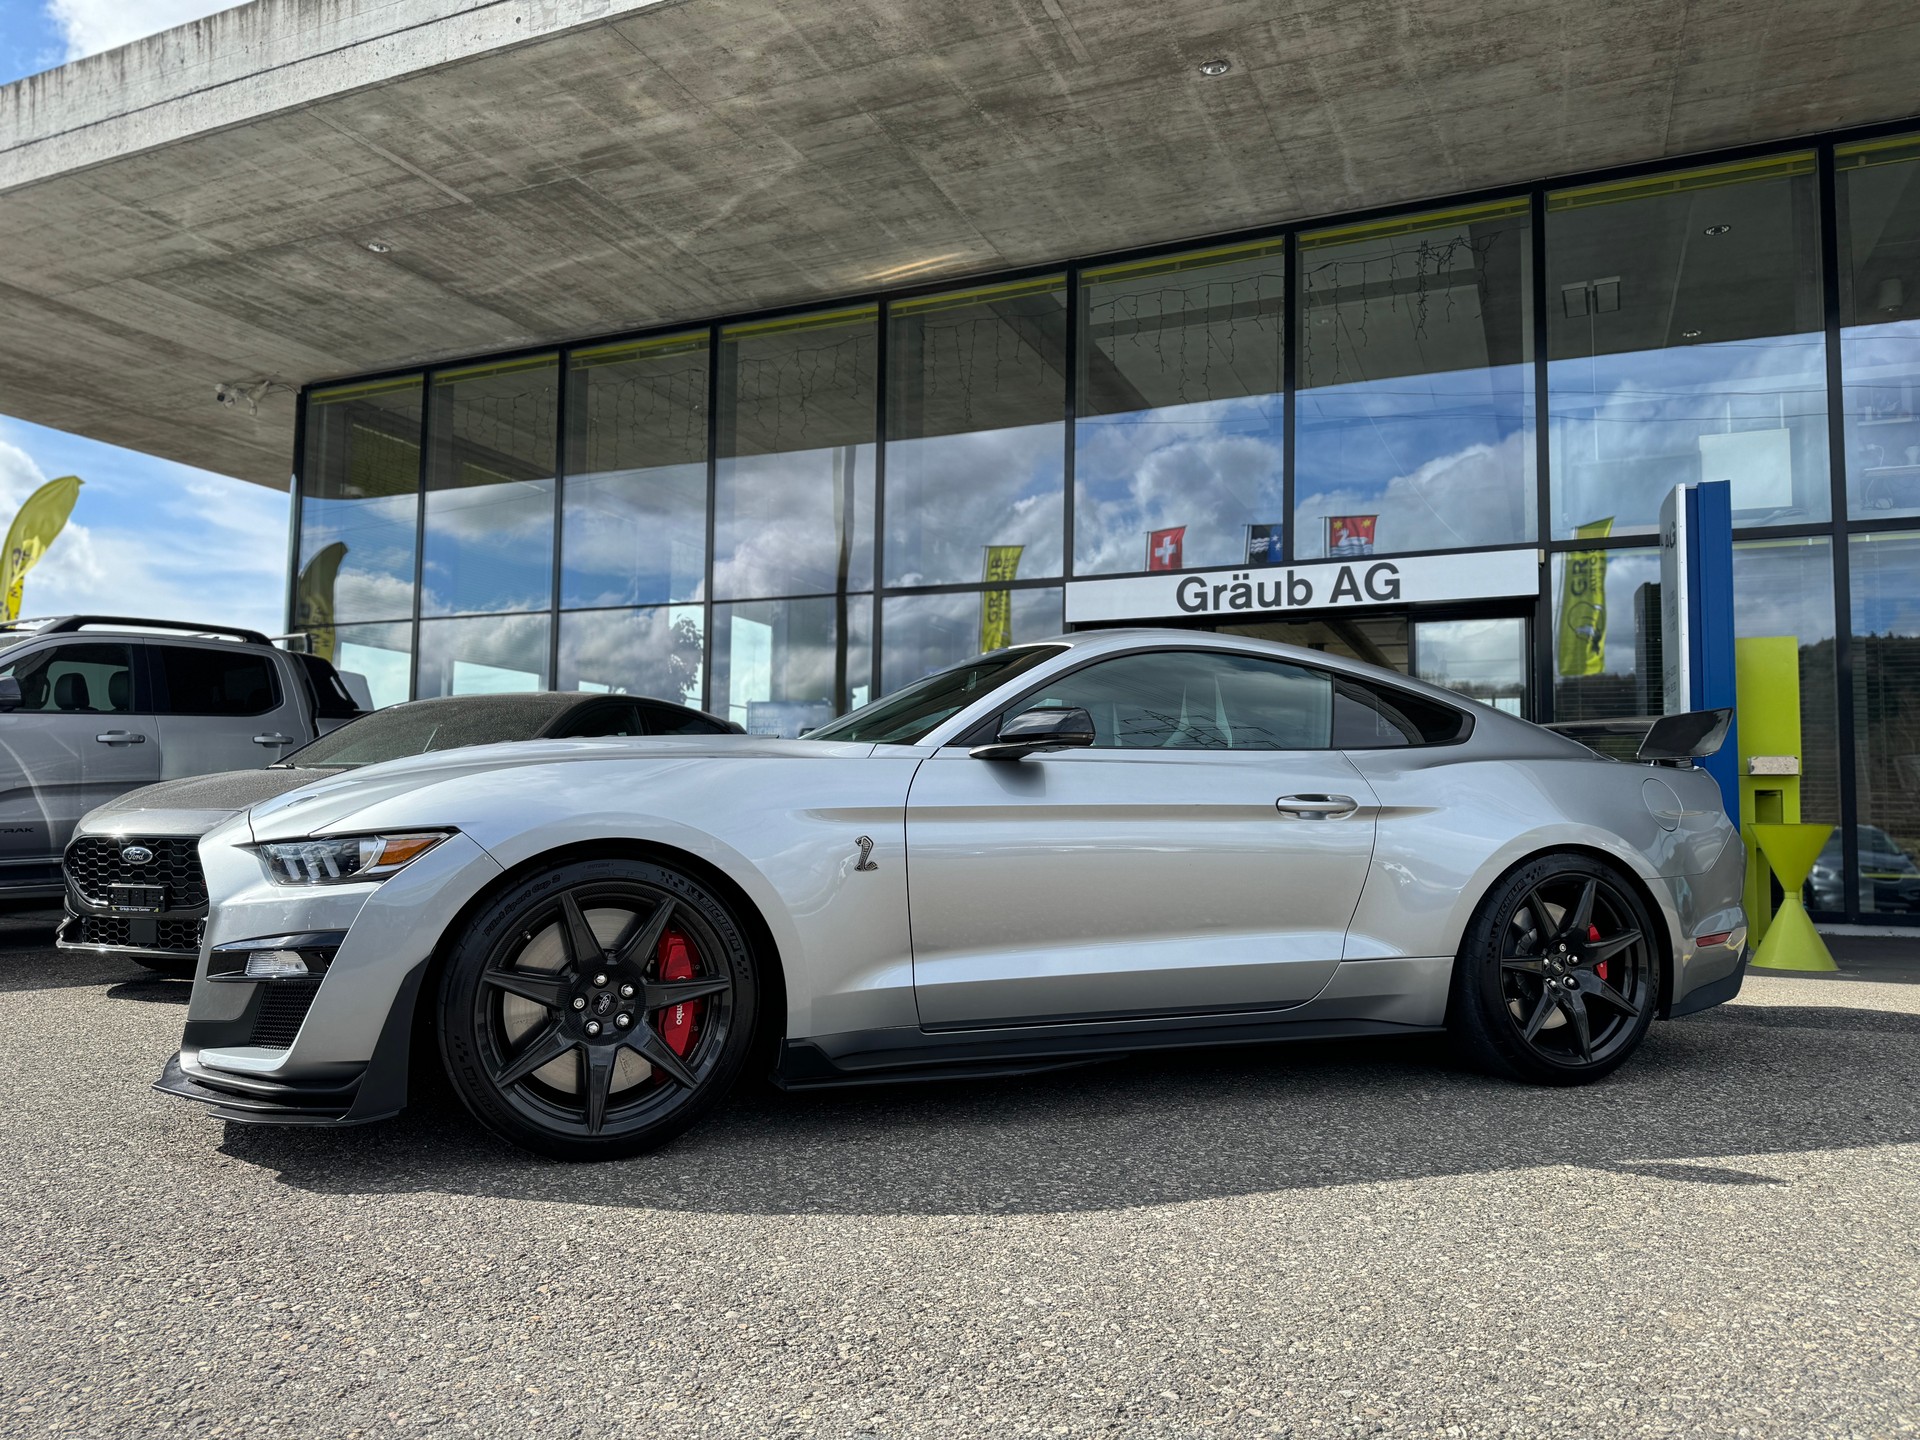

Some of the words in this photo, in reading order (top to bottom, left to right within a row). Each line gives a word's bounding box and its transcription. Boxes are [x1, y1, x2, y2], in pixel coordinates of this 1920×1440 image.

[987, 558, 1003, 624] GRUB
[1175, 569, 1313, 613] Gräub
[1328, 561, 1401, 604] AG
[504, 889, 532, 915] Sport
[531, 880, 552, 893] Cup
[699, 896, 742, 950] MICHELIN
[1495, 878, 1527, 926] MICHELIN
